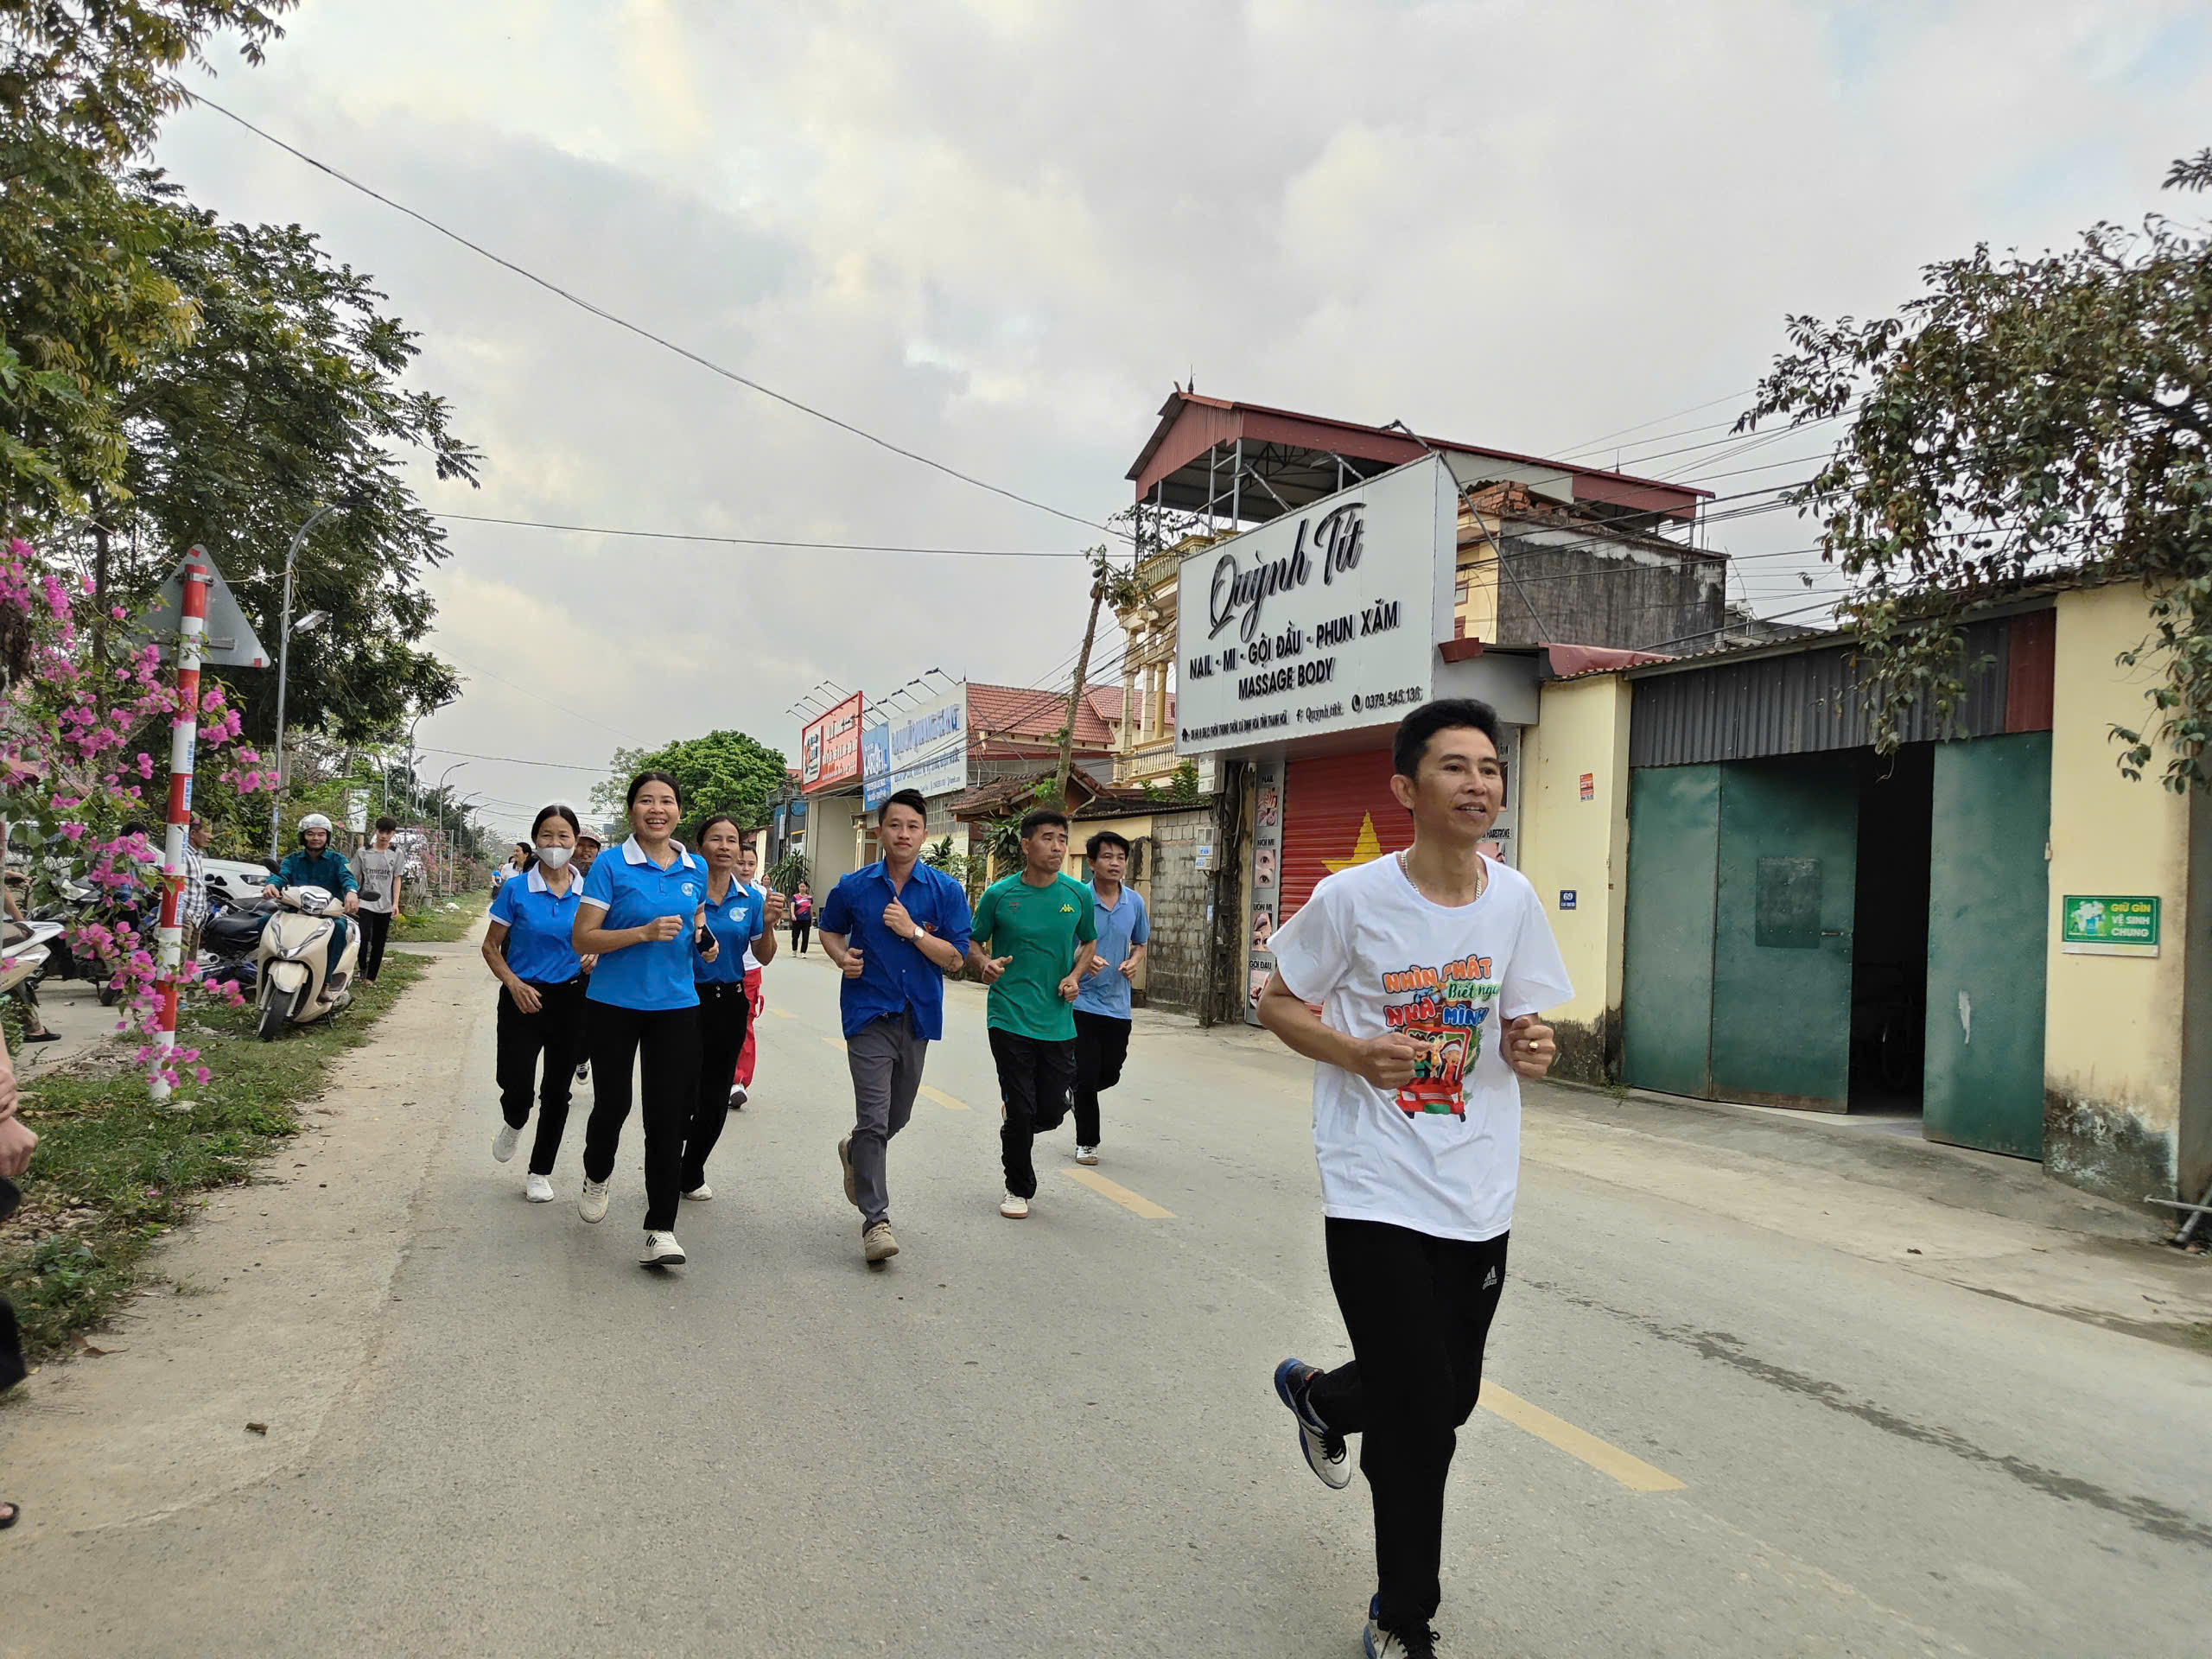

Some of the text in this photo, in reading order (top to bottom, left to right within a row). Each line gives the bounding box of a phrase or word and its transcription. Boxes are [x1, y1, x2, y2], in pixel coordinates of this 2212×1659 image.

[1208, 518, 1312, 643] Quỳnh
[1190, 598, 1401, 679] NAIL MI GỘI ĐẦU PHUN XĂM
[1238, 657, 1335, 700] MASSAGE BODY
[1563, 892, 1573, 900] 69
[2126, 915, 2151, 925] SINH
[2111, 927, 2150, 938] CHUNG
[1382, 954, 1492, 994] NHÌN PHÁT
[1448, 982, 1475, 999] Biết
[1442, 1003, 1490, 1027] MÌNH
